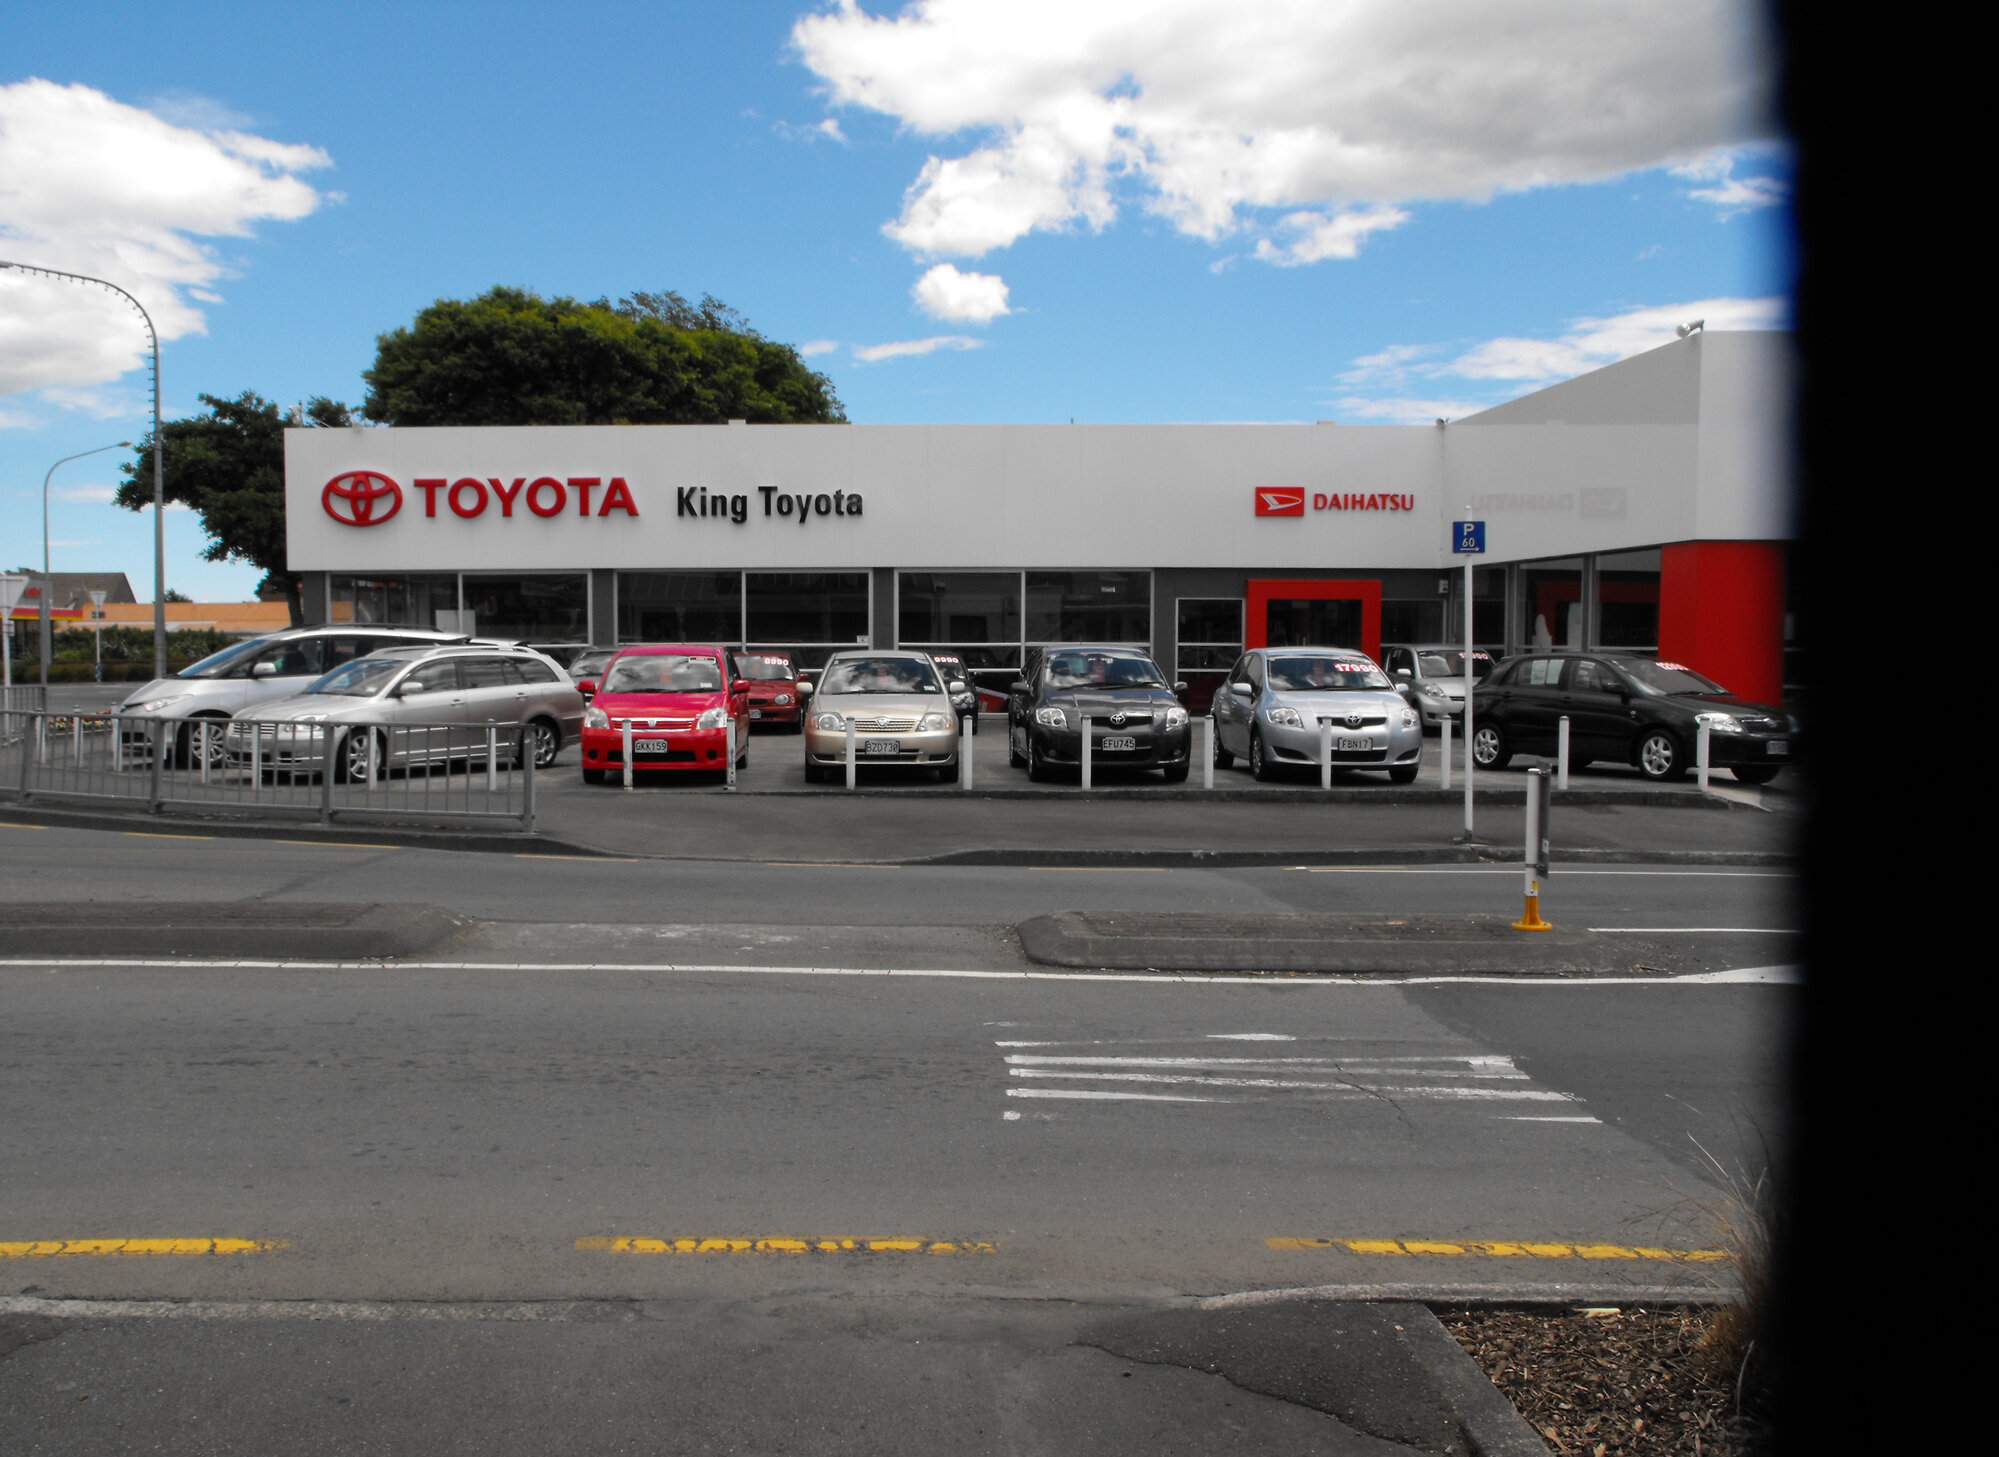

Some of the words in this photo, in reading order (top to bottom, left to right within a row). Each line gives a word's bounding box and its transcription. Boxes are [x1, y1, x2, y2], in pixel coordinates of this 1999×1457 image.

[413, 476, 639, 519] TOYOTA
[1313, 493, 1414, 511] DAIHATSU
[676, 485, 748, 524] King
[758, 485, 864, 524] Toyota
[1463, 523, 1475, 536] P
[1462, 537, 1475, 548] 60
[1334, 663, 1379, 673] 17990
[1103, 738, 1135, 749] EFU745
